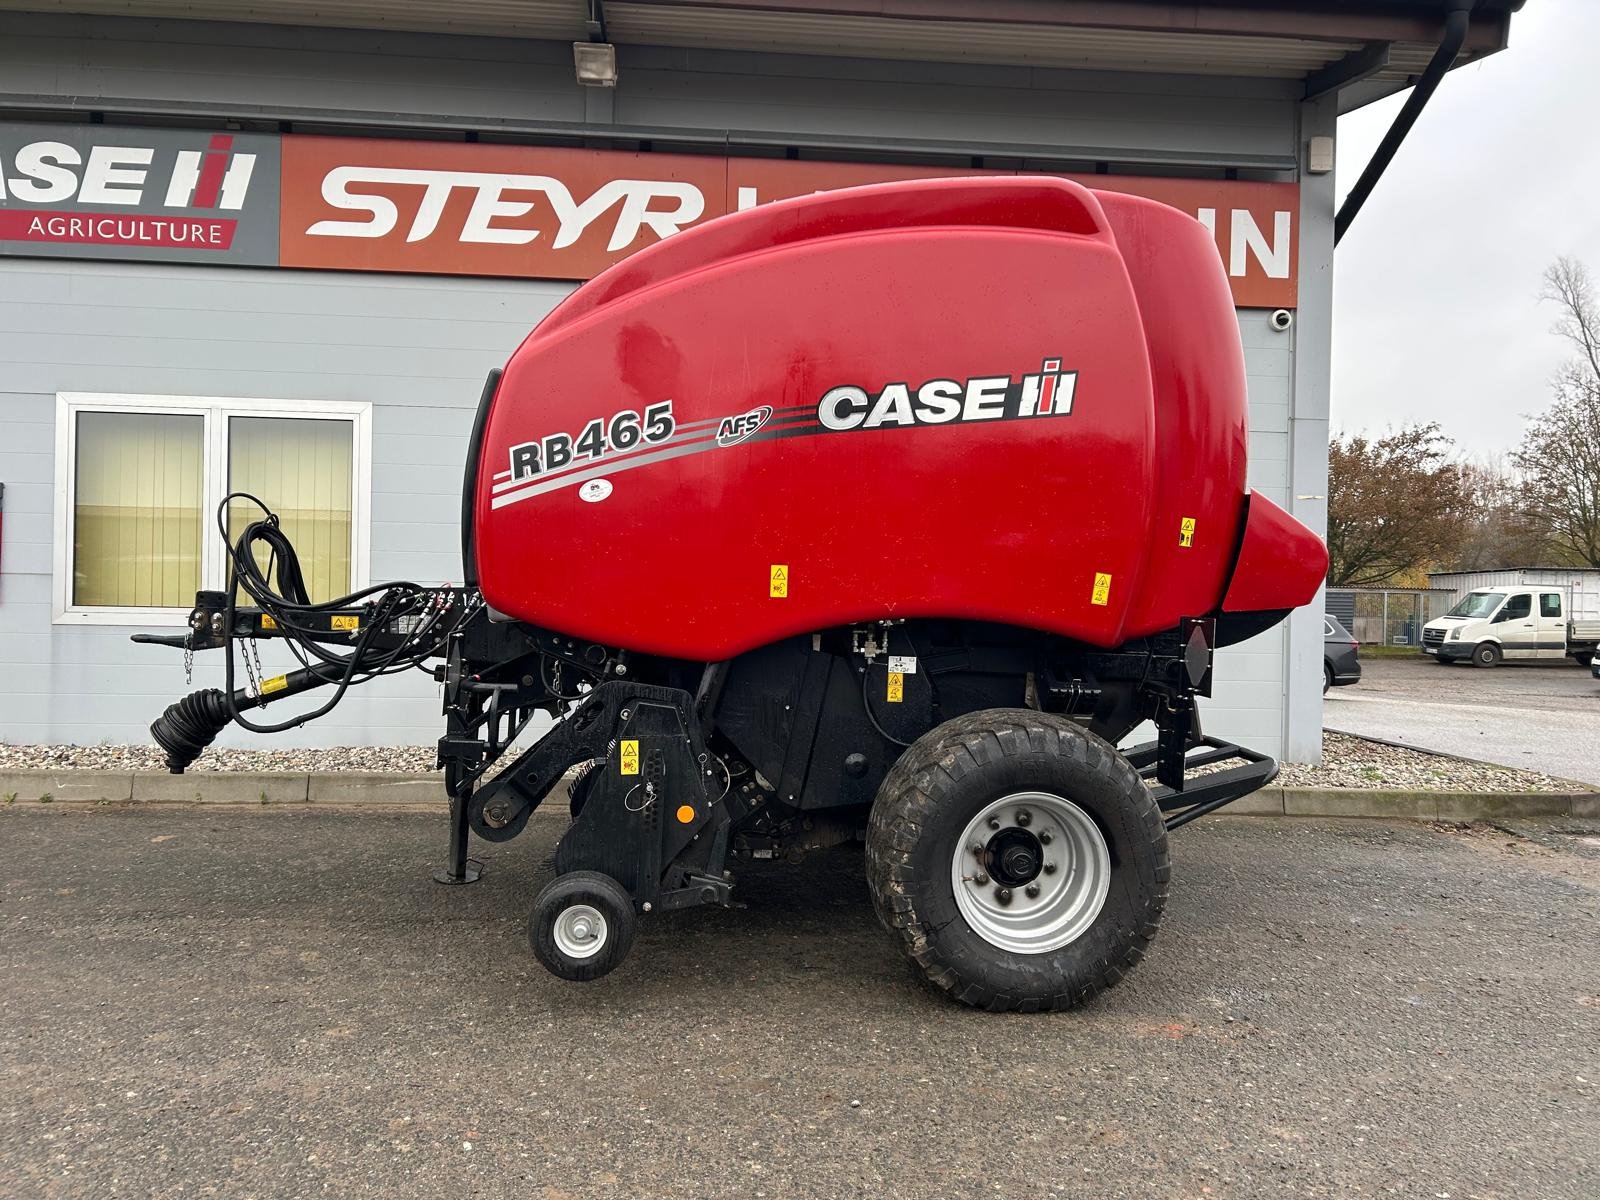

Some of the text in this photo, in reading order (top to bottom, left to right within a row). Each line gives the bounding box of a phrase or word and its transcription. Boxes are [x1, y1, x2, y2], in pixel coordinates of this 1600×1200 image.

[27, 215, 222, 244] AGRICULTURE
[305, 165, 705, 253] STEYR
[715, 411, 761, 440] AFS
[817, 376, 1011, 431] CASE
[509, 399, 676, 482] RB465
